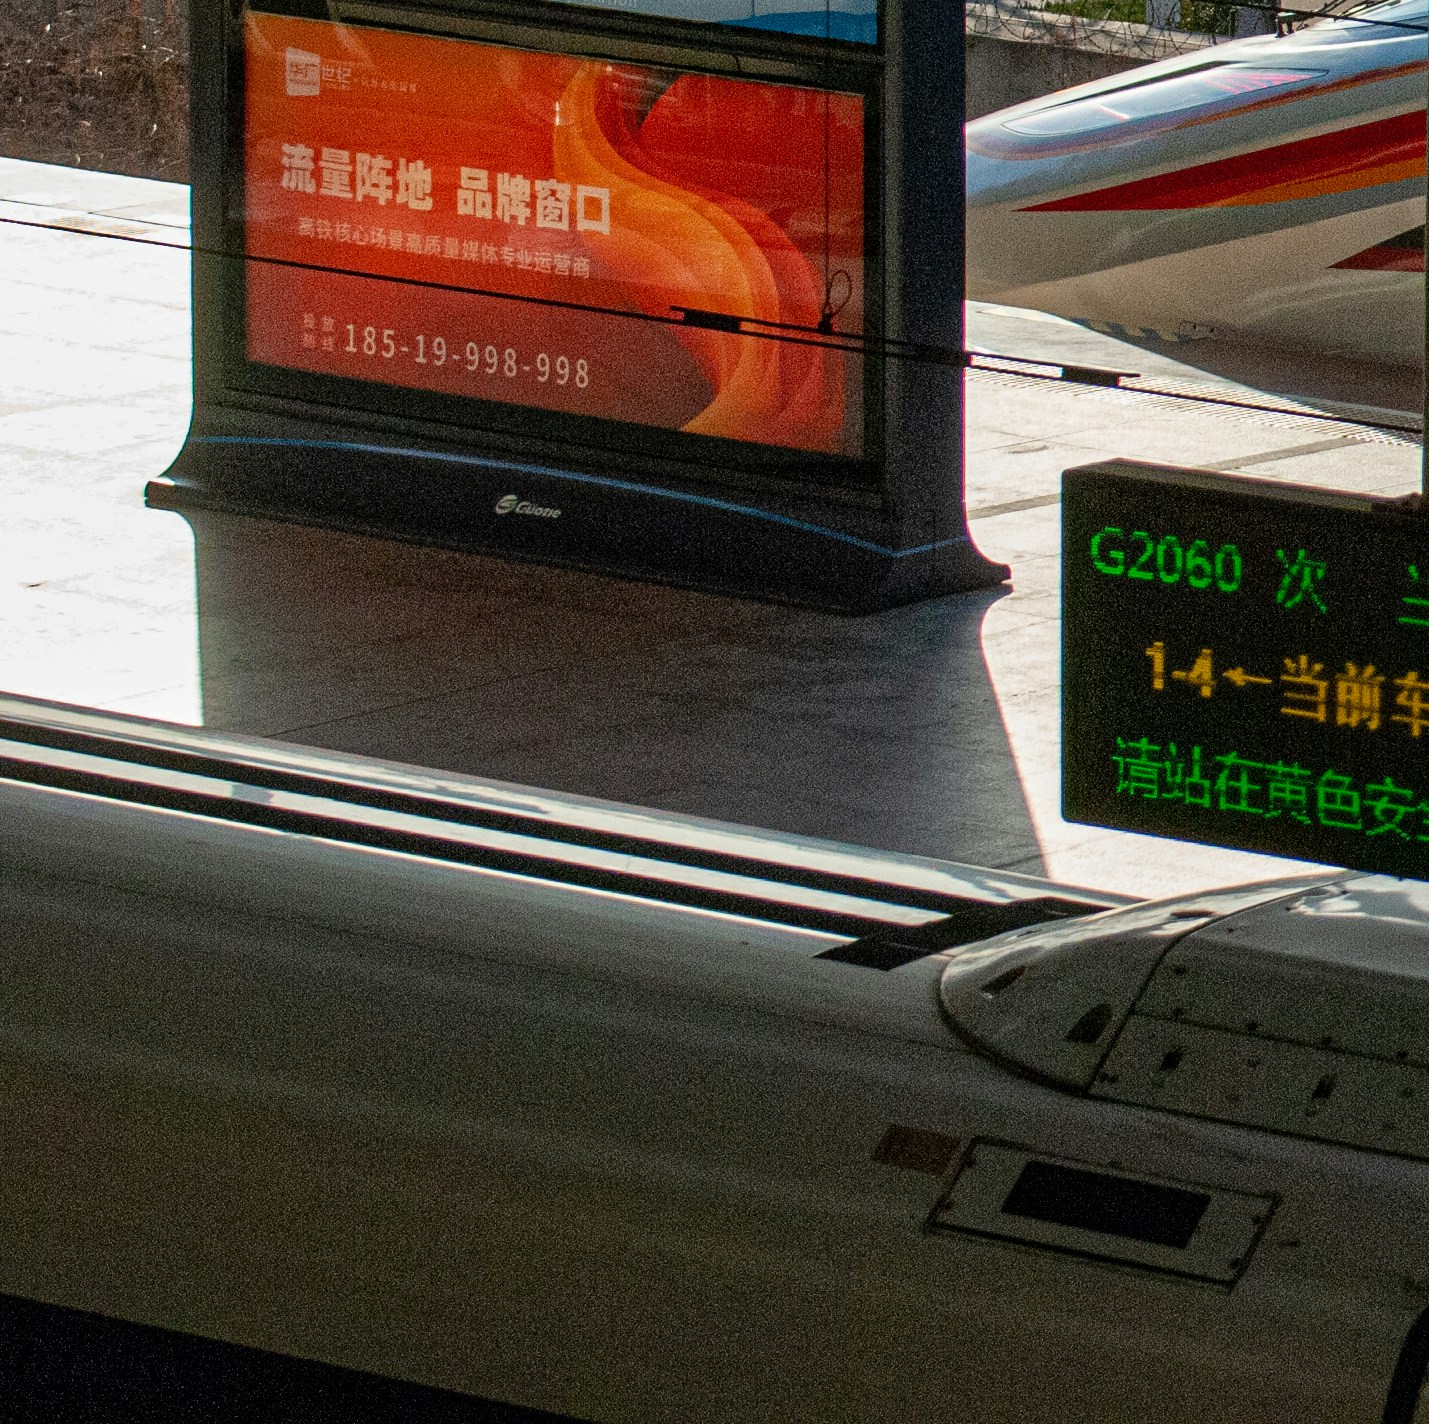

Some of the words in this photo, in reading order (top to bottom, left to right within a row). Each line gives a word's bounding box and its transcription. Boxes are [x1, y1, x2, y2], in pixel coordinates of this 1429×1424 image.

[281, 143, 433, 211] 流量阵地
[457, 166, 611, 235] 品牌窗口
[345, 323, 590, 388] 185-19-998-998
[1089, 526, 1243, 593] G2060
[1276, 547, 1328, 615] 次
[1145, 641, 1216, 699] 1-4
